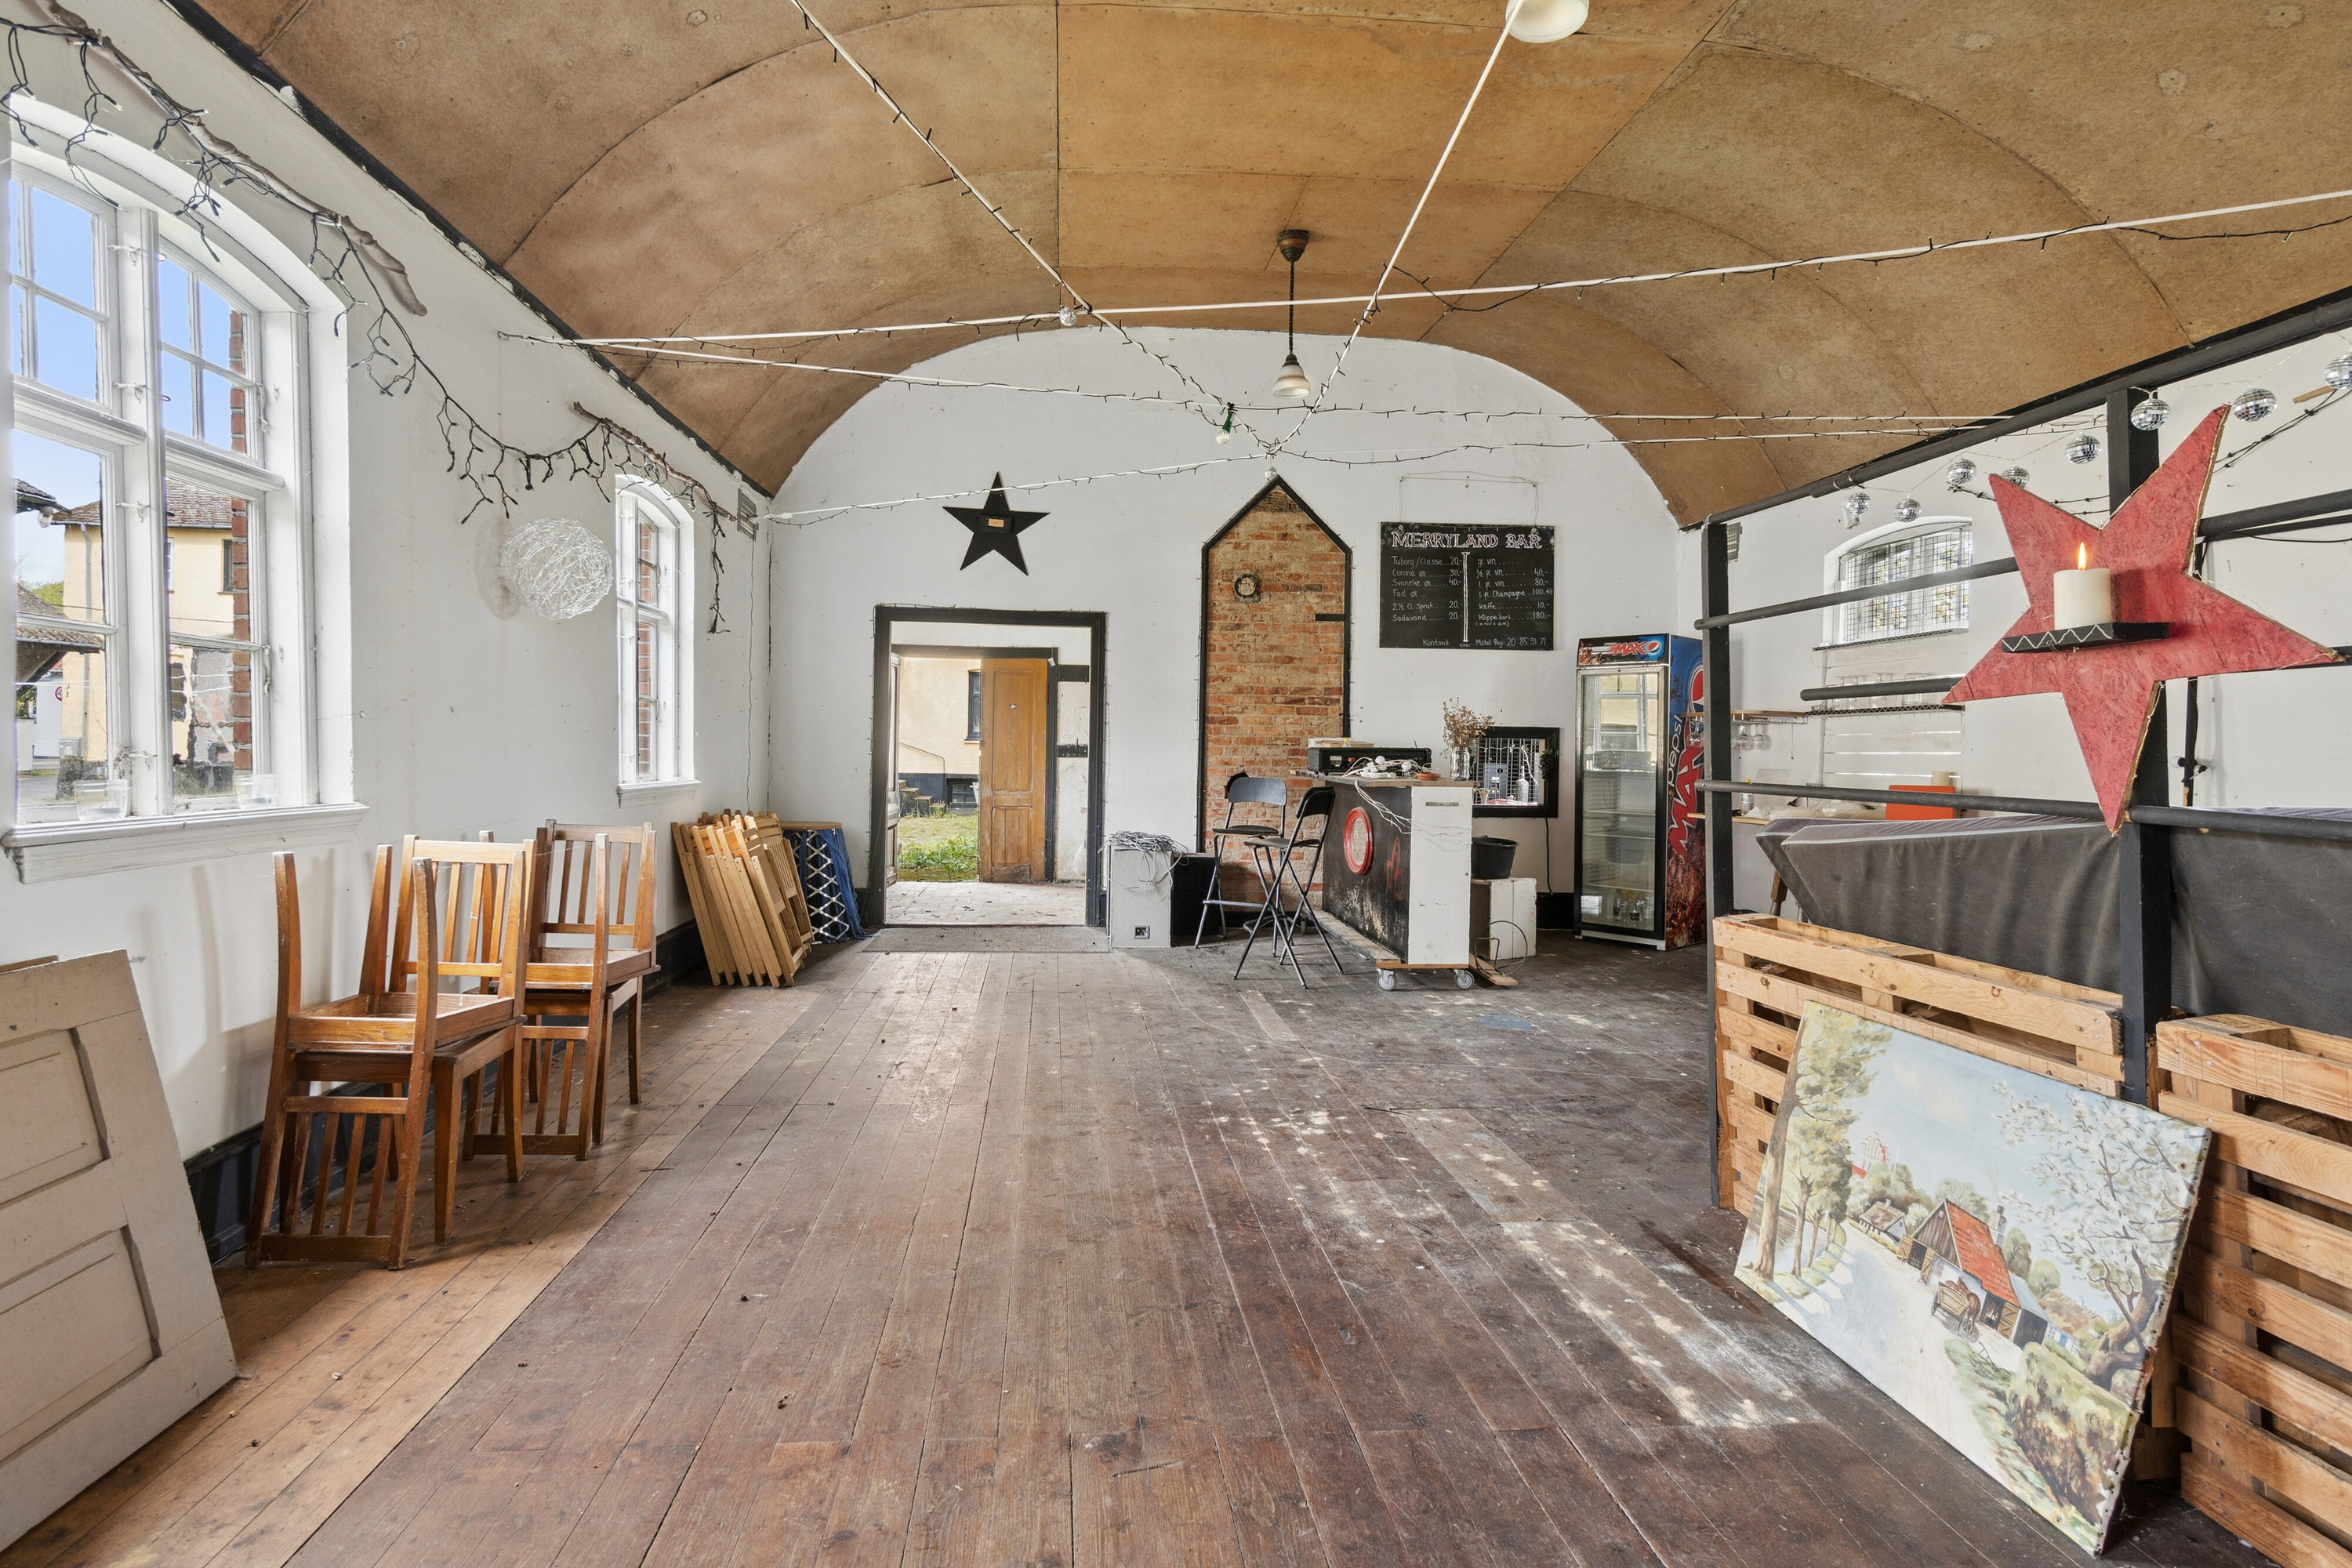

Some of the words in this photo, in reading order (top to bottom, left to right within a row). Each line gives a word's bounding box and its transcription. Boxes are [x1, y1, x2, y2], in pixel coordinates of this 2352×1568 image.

[1391, 532, 1498, 548] MERRYLAND
[1505, 533, 1542, 549] BAR
[1493, 590, 1526, 600] Champagne
[1507, 637, 1515, 646] 20
[1612, 641, 1647, 657] MAX
[1668, 714, 1683, 788] pepsi
